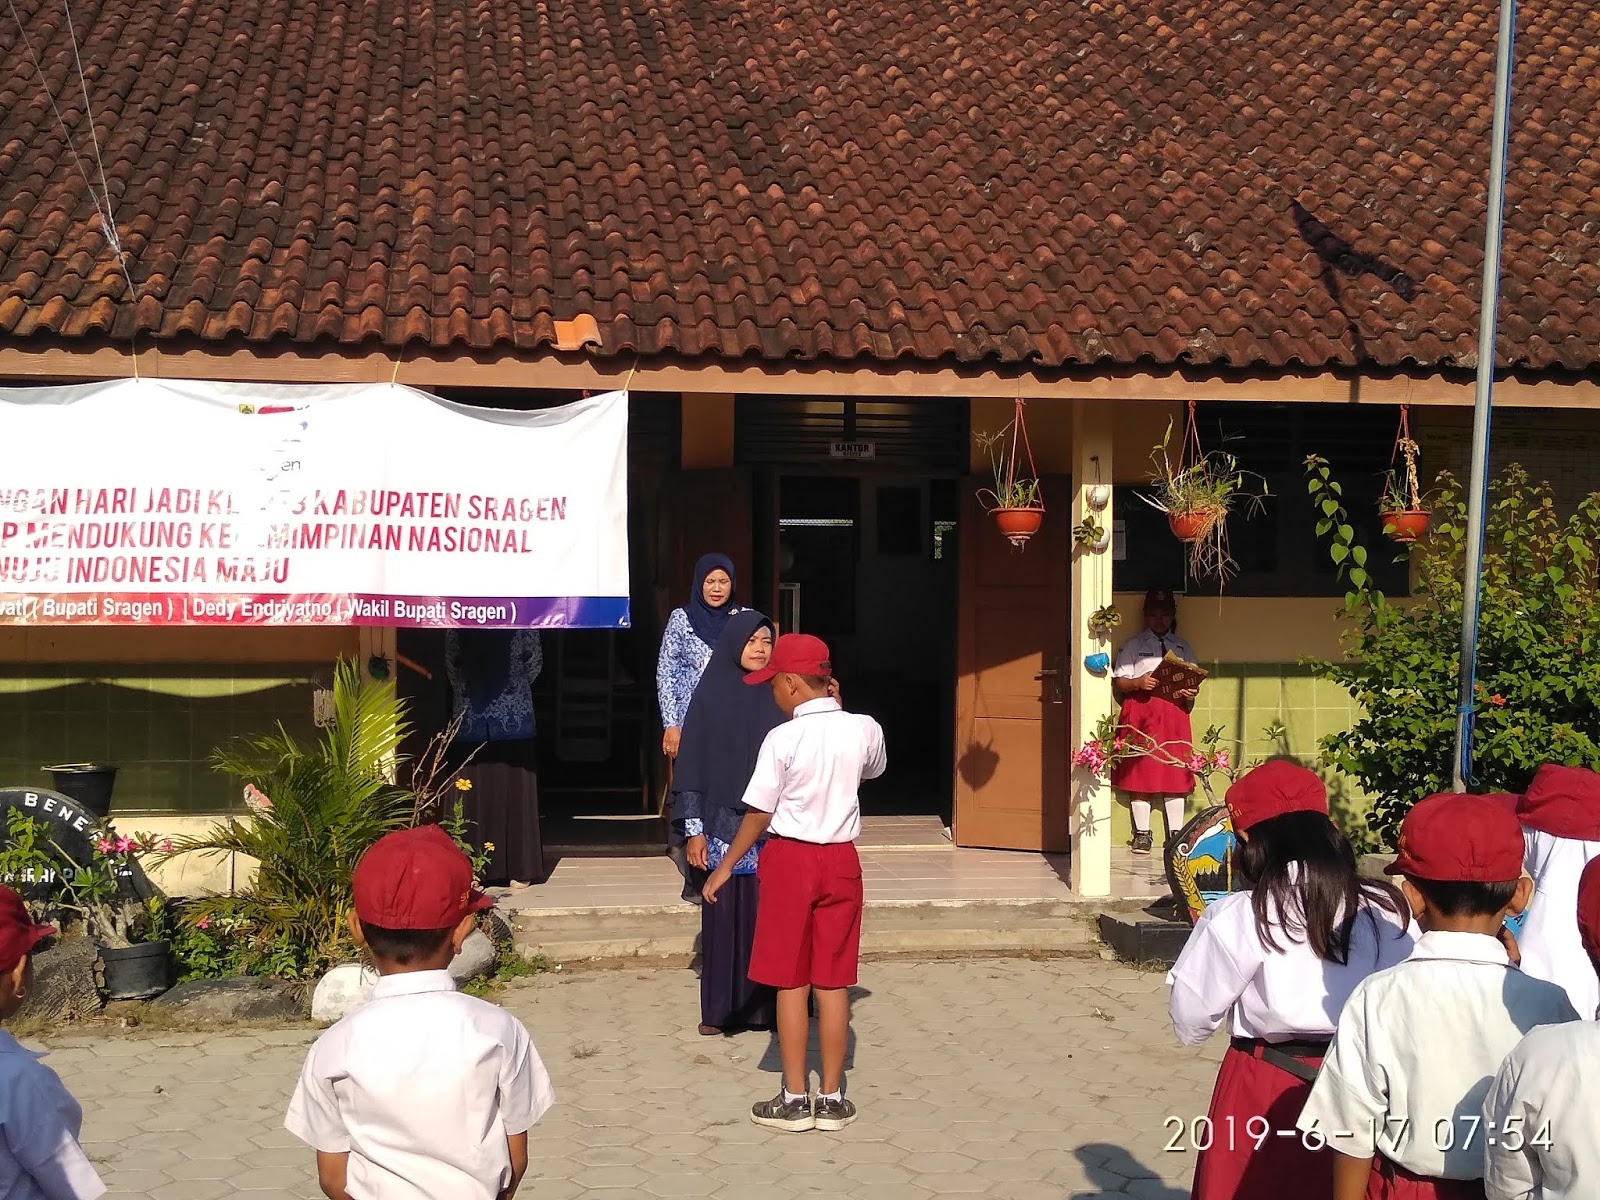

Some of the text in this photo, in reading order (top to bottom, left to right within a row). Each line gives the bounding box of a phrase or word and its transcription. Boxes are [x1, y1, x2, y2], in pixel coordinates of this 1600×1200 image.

[835, 443, 869, 452] KANTOR
[75, 487, 137, 515] HARI
[144, 487, 201, 515] JADI
[314, 489, 461, 518] KABUPATEN
[468, 494, 567, 522] SRAGEN
[26, 521, 193, 550] MENDUKUNG
[199, 522, 402, 550] KEMIMPINAN
[408, 525, 533, 554] NASIONAL
[67, 555, 207, 583] INDONESIA
[216, 556, 290, 583] MAJU
[43, 598, 98, 620] Bupati
[103, 597, 163, 621] Sragen
[193, 598, 236, 621] Dedy
[348, 598, 390, 618] Wakil
[394, 600, 446, 623] Bupati
[451, 601, 506, 624] Sragen
